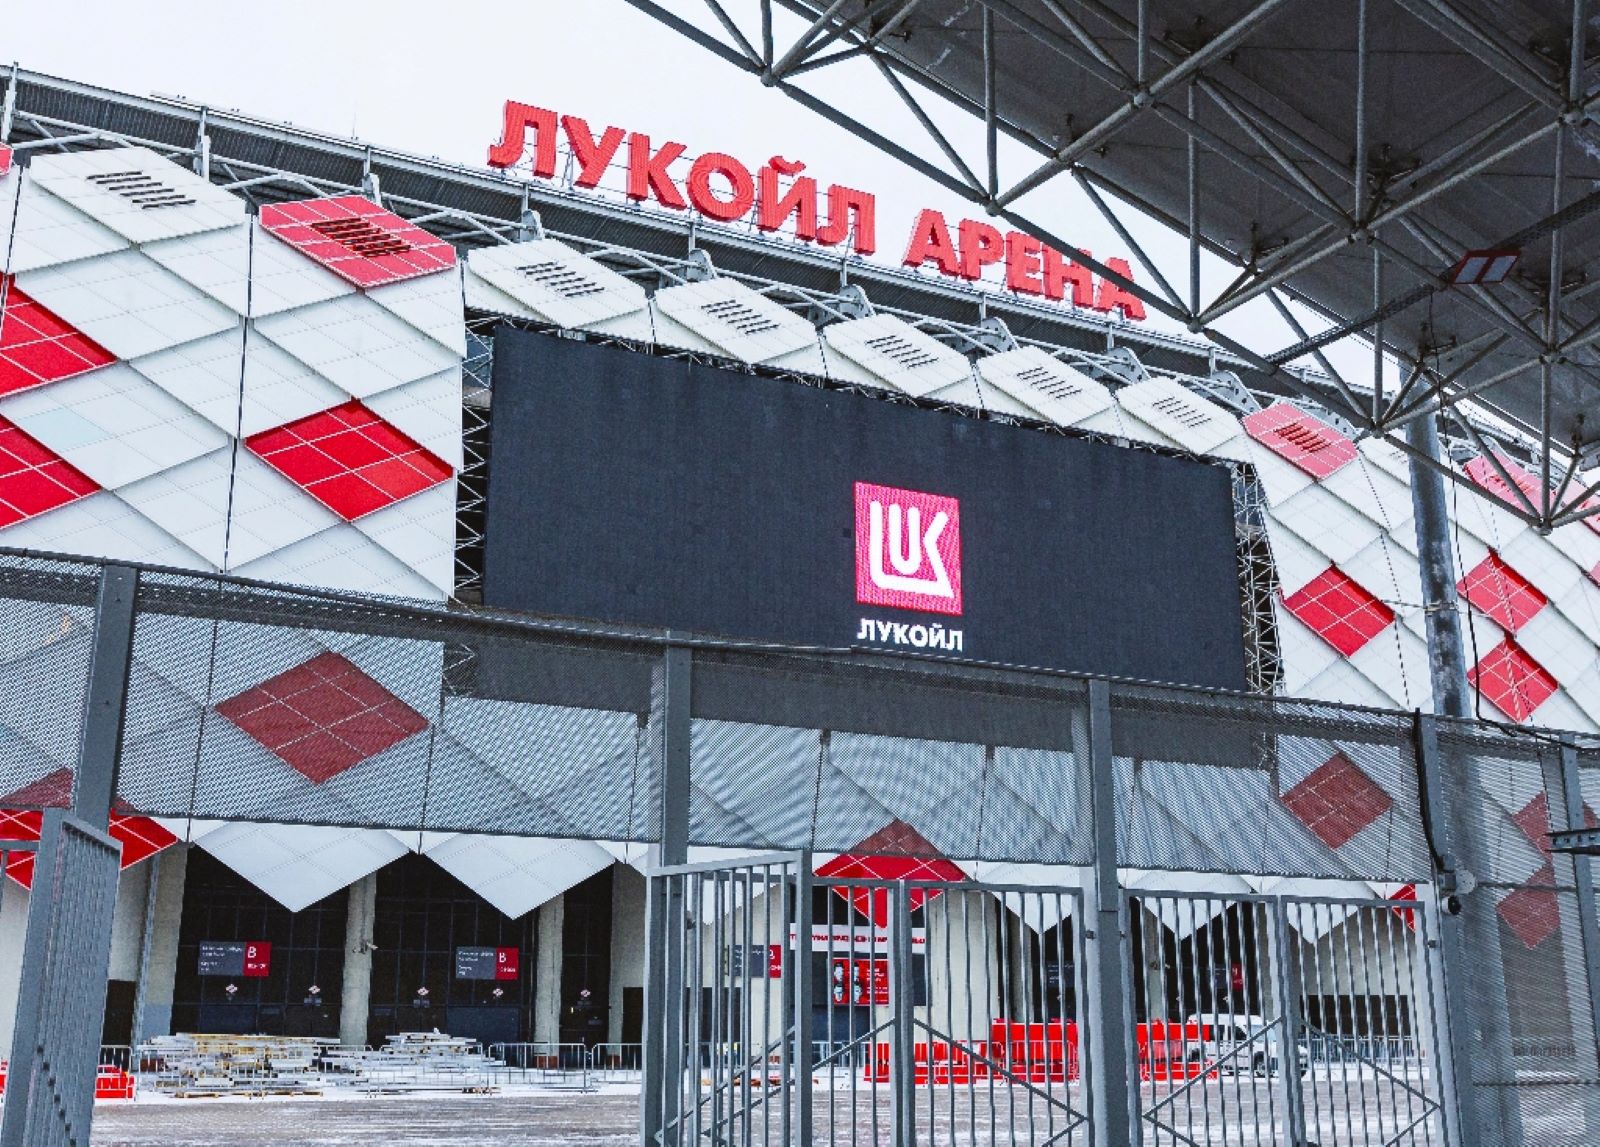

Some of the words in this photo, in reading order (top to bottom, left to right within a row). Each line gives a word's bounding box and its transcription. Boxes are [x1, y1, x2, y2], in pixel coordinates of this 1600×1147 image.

[487, 100, 876, 256] ЛУКОЙЛ
[902, 208, 1147, 321] АРЕНА
[857, 617, 963, 652] ЛУКОЙЛ
